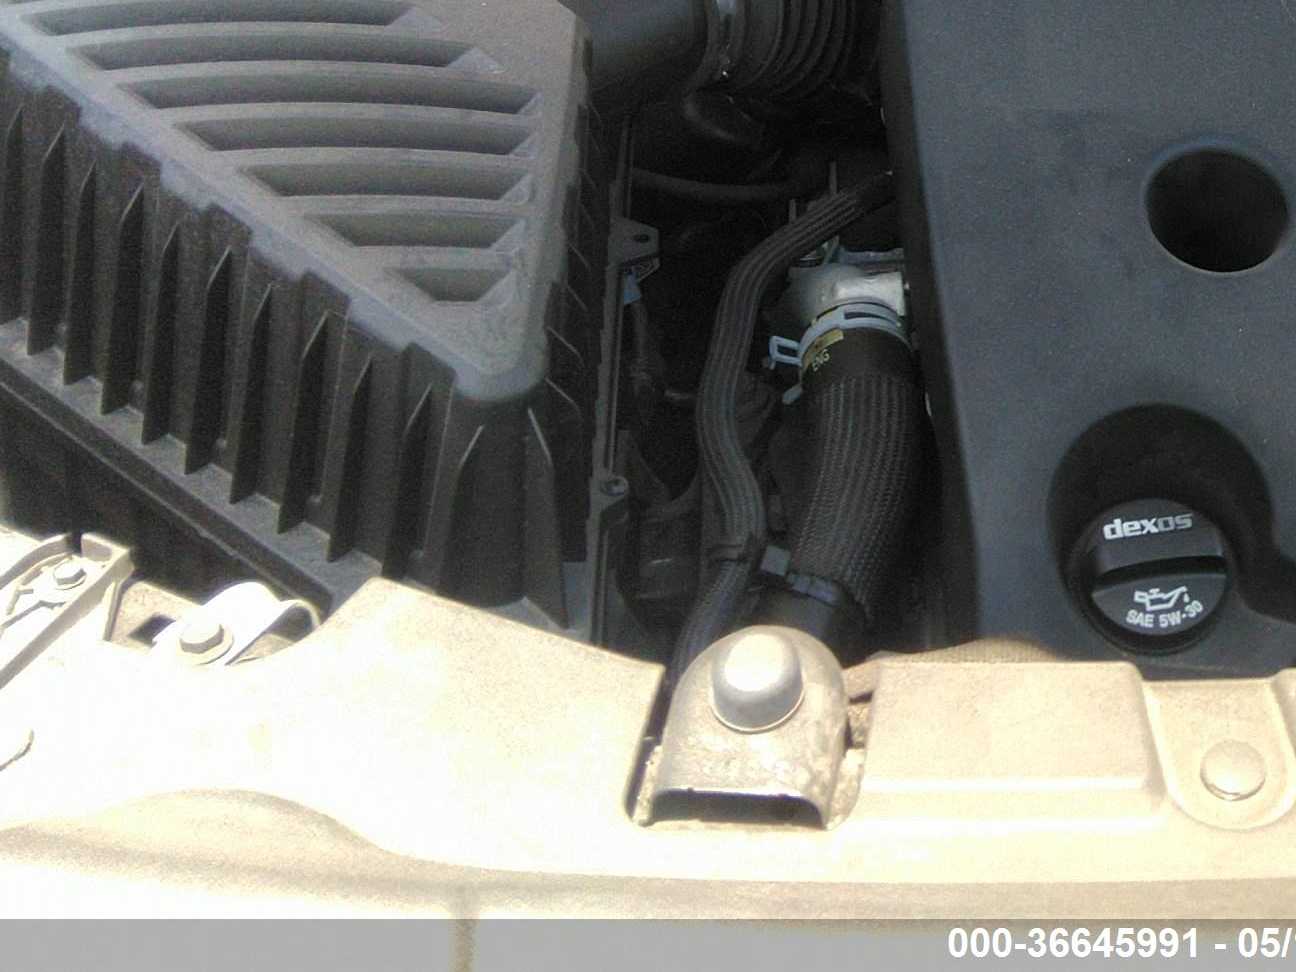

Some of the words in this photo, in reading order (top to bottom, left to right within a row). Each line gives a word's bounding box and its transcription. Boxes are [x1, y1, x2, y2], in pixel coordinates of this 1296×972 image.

[812, 348, 830, 372] ENG
[1103, 513, 1194, 540] dexos
[1126, 609, 1154, 628] SAE
[1159, 600, 1204, 628] 5W-30
